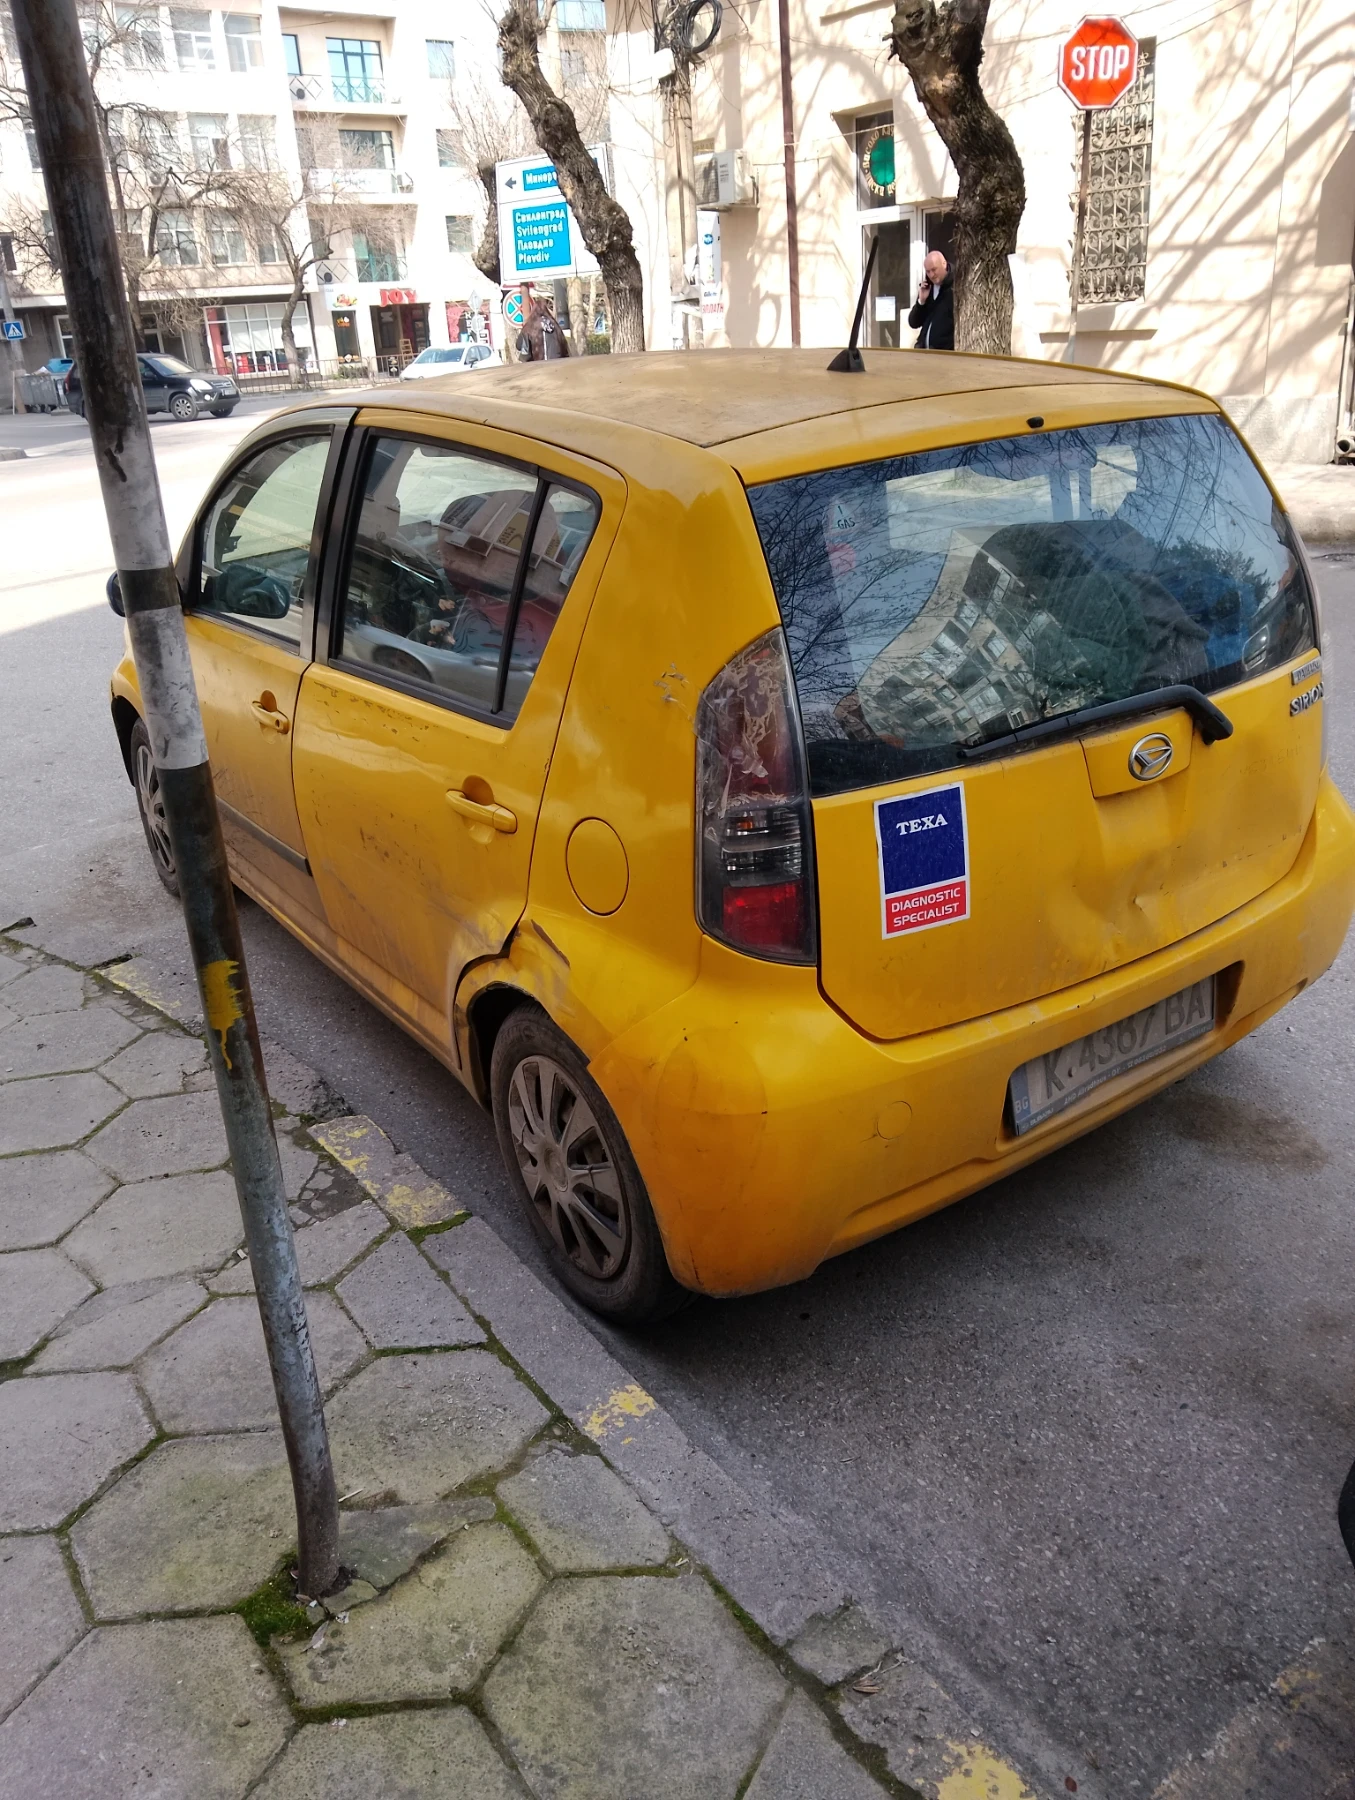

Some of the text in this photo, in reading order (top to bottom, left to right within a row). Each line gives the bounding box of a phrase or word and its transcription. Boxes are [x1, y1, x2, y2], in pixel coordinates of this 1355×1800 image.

[1071, 45, 1130, 81] STOP
[516, 221, 564, 237] Svilengrad
[518, 251, 550, 264] Plovdiv
[379, 288, 417, 308] JOY
[837, 517, 856, 530] GAS
[1290, 681, 1324, 717] SIRION
[896, 813, 948, 836] TEXA
[891, 887, 961, 914] DIAGNOSTIC
[893, 902, 960, 928] SPECIALIST
[1015, 1095, 1029, 1114] BG
